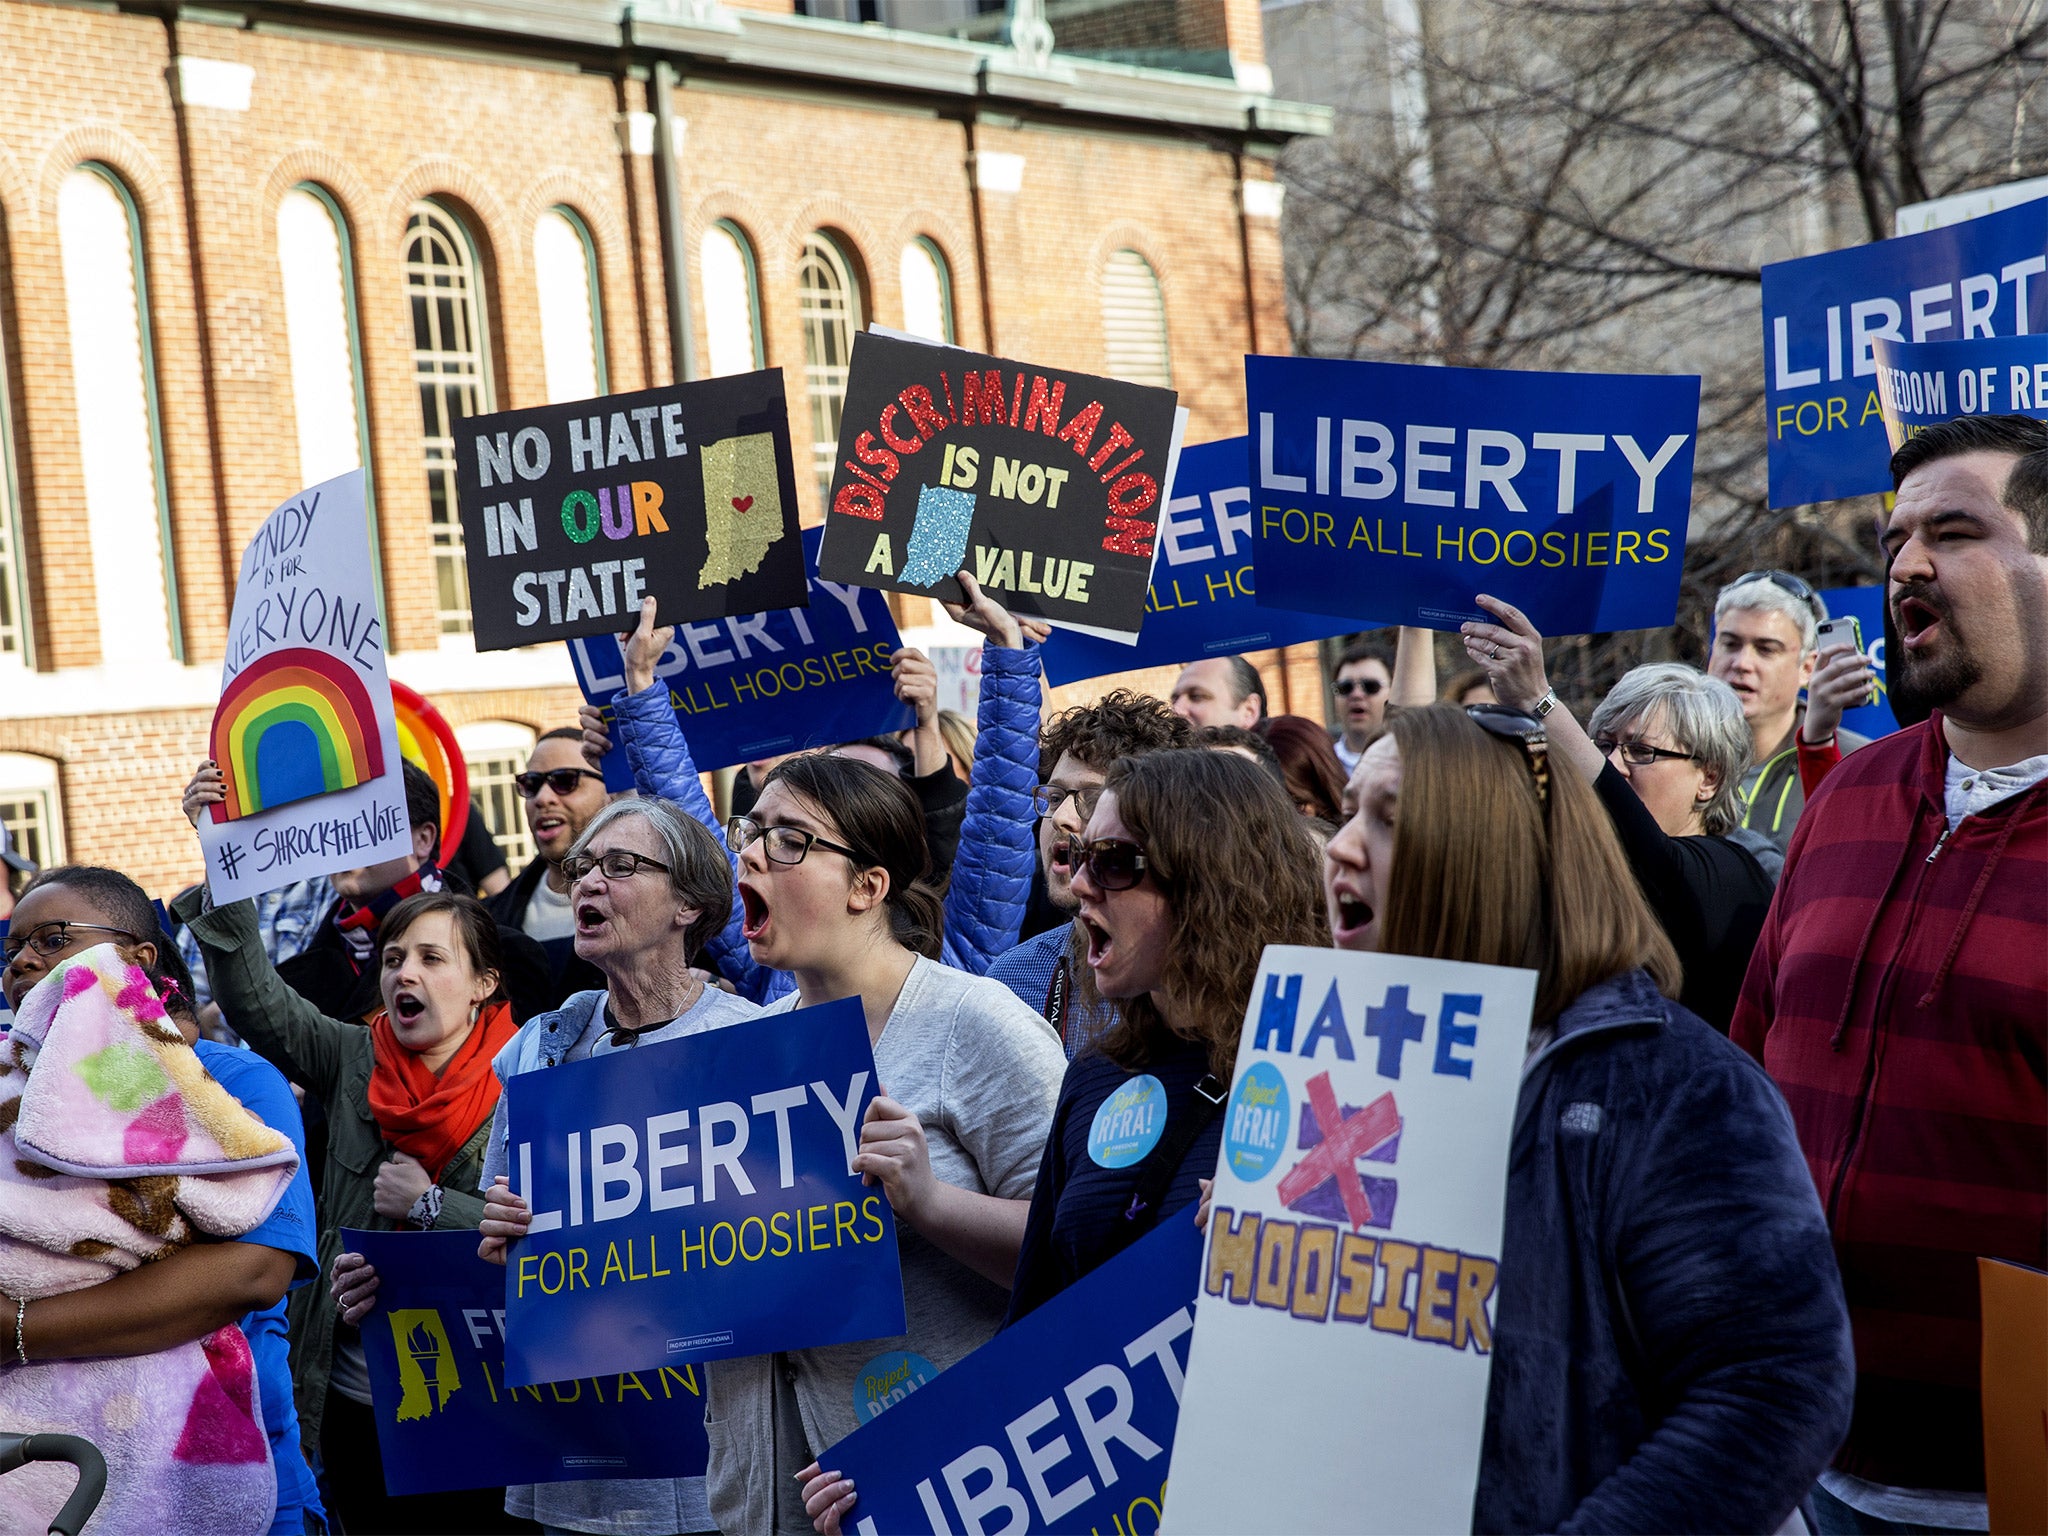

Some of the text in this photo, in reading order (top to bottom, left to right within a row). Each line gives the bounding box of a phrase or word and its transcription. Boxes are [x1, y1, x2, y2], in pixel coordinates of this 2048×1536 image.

[1773, 254, 2047, 391] LIBERT
[1776, 396, 1849, 440] FOR
[1958, 367, 1998, 414] OF
[2010, 363, 2048, 411] RE
[475, 402, 688, 488] NO HATE
[833, 369, 1158, 558] DISCRIMINATION
[939, 443, 1070, 509] IS NOT
[1259, 411, 1690, 514] LIBERTY
[248, 491, 321, 585] INDY
[483, 480, 671, 558] IN OUR
[1262, 505, 1336, 548] FOR
[1347, 515, 1423, 558] ALL
[1436, 523, 1671, 568] HOOSIERS
[264, 554, 308, 590] IS FOR
[512, 556, 648, 628] STATE
[864, 532, 1096, 604] A VALUE
[1144, 570, 1199, 614] LL
[227, 586, 382, 676] VERYONE
[671, 682, 729, 715] ALL
[729, 641, 895, 704] HOOSIERS
[518, 1070, 871, 1236] LIBERTY
[1096, 1103, 1155, 1145] RFRA!
[1230, 1103, 1281, 1150] RFRA!
[517, 1195, 885, 1299] FOR ALL HOOSIERS
[1204, 1206, 1499, 1356] HOOSIER
[864, 1358, 912, 1403] Reject
[857, 1305, 1195, 1536] IBERT
